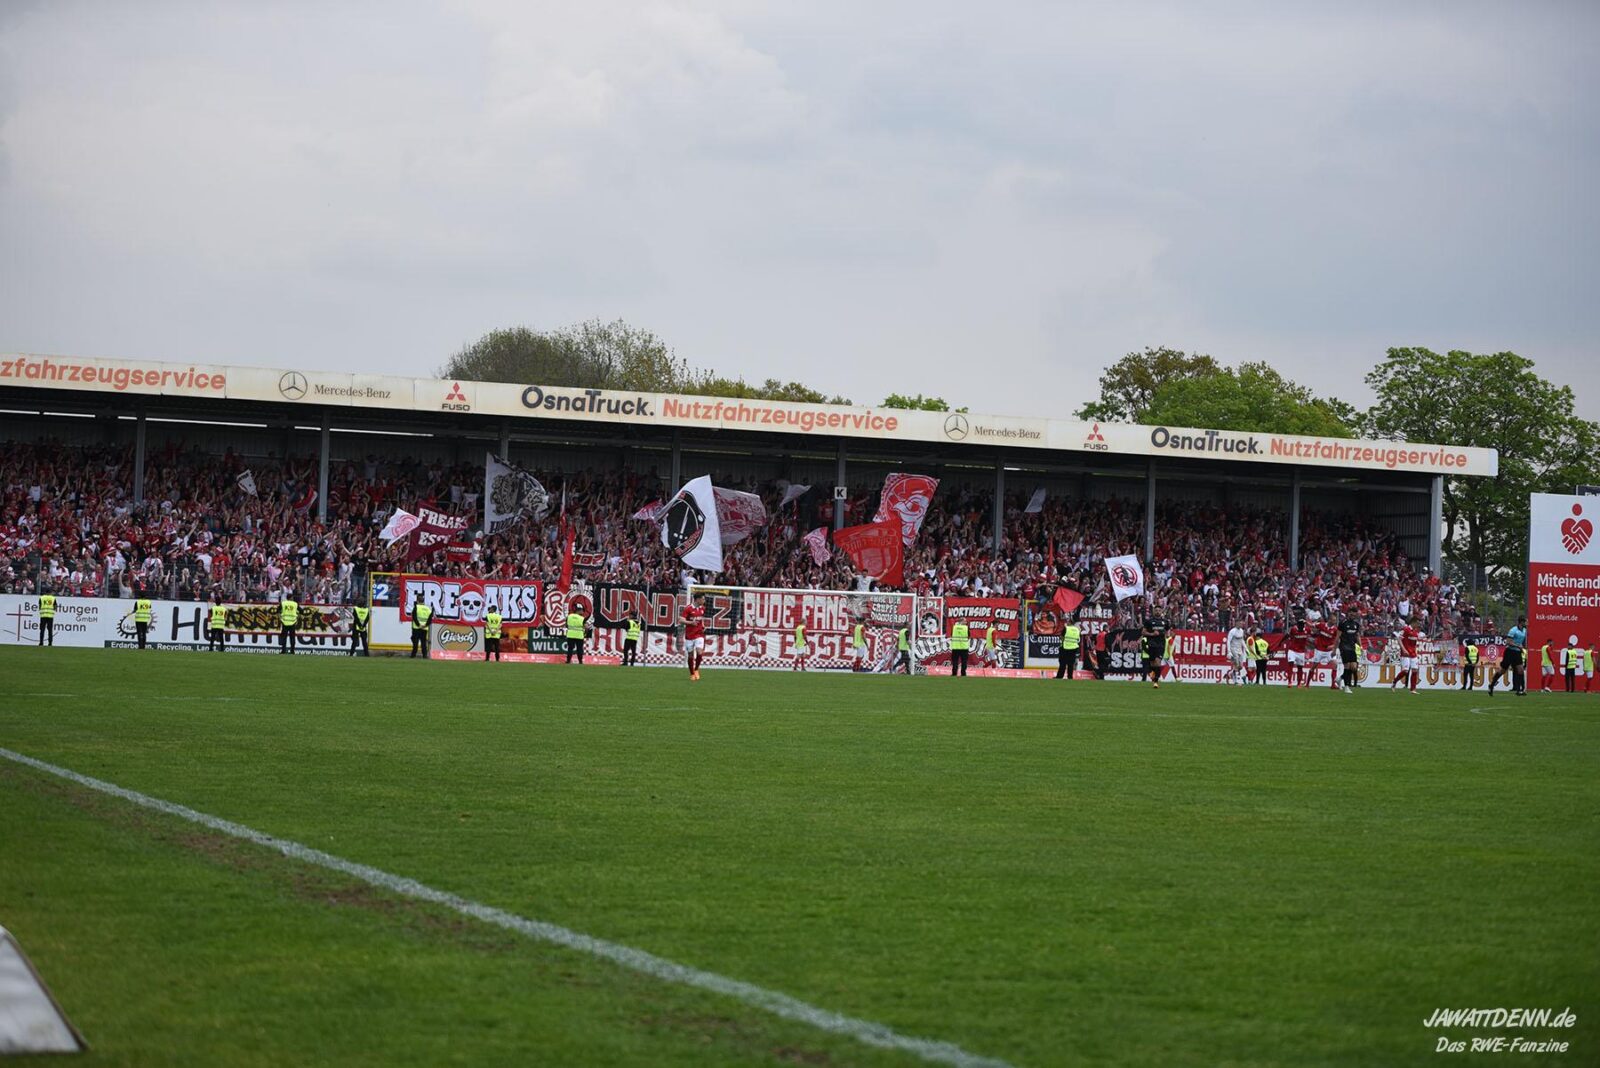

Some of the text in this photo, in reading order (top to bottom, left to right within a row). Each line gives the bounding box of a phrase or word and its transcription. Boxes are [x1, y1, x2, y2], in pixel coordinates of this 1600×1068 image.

[0, 357, 226, 391] zfahrzeugservice
[314, 384, 391, 399] Mercedes-Benz
[441, 403, 470, 411] FUSO
[521, 386, 898, 432] OsnaTruck. Nutzfahrzeugservice
[974, 425, 1041, 440] Mercedes-Benz
[1151, 427, 1467, 468] OsnaTruck. Nutzfahrzeugservice
[836, 488, 844, 498] K
[404, 580, 536, 621] FREAKS
[1537, 591, 1553, 605] ist
[744, 592, 849, 631] RUDE FANS
[995, 608, 1017, 620] CREW
[532, 642, 559, 651] WILL
